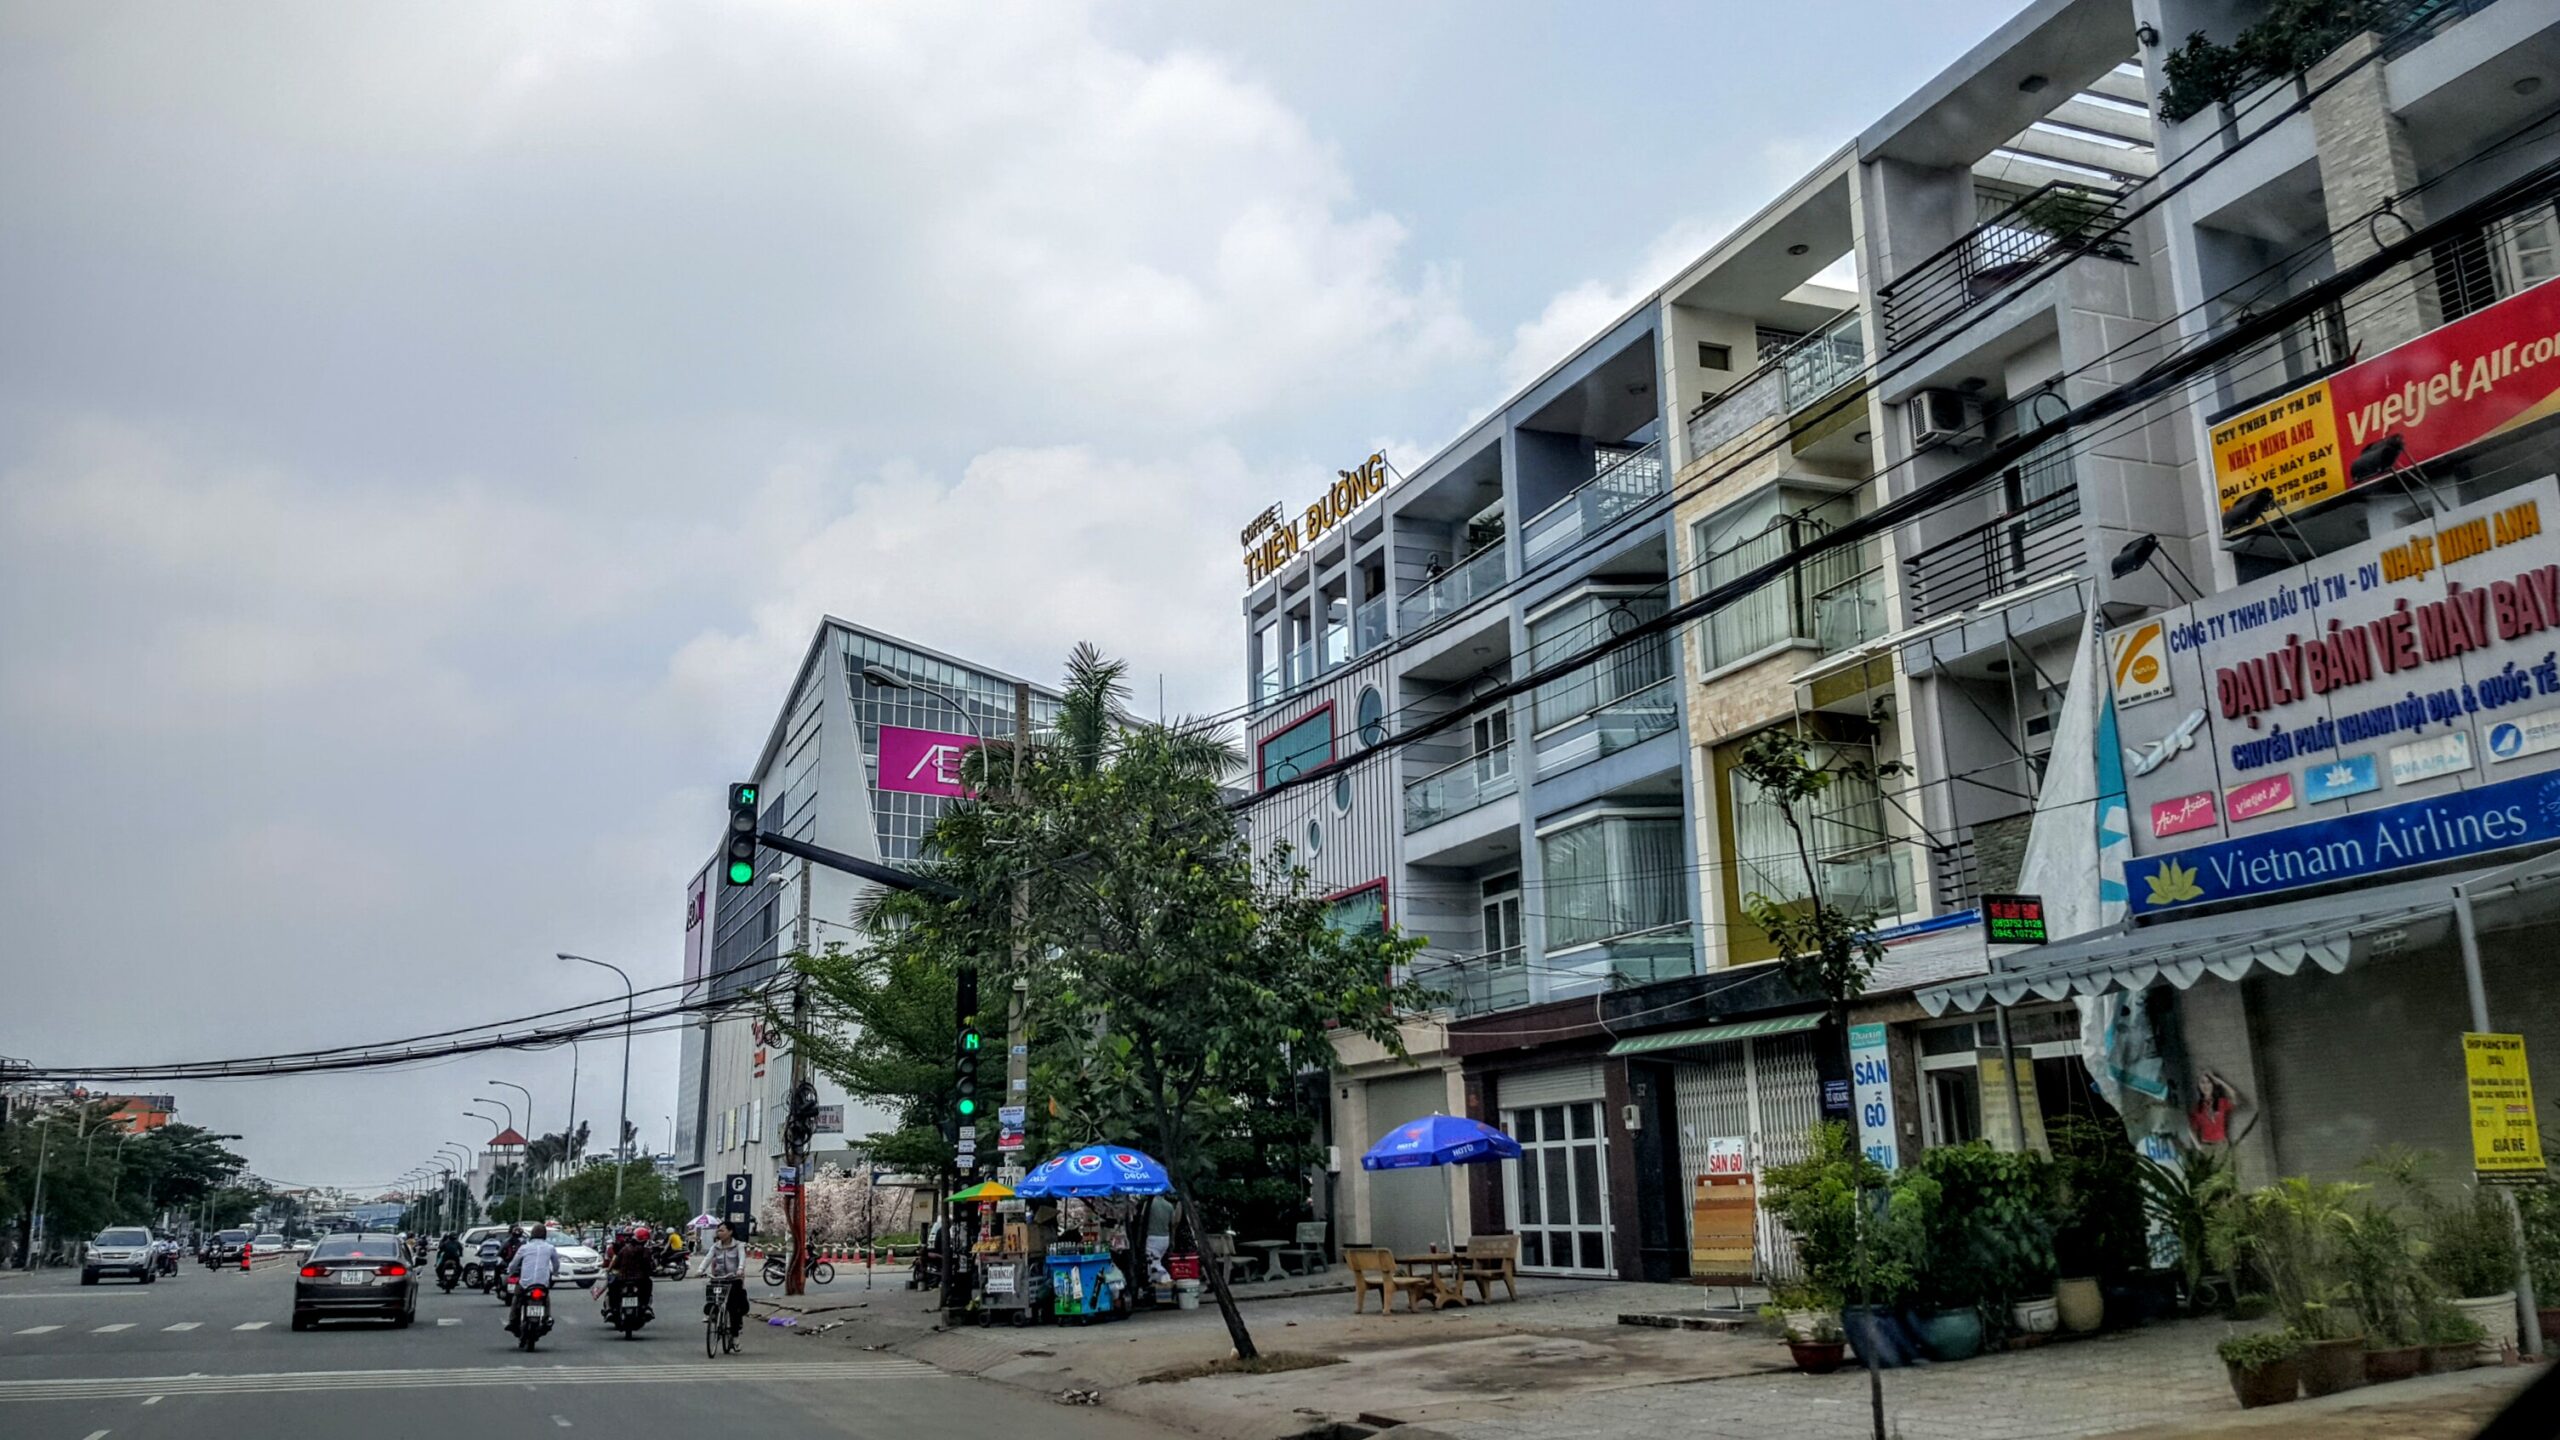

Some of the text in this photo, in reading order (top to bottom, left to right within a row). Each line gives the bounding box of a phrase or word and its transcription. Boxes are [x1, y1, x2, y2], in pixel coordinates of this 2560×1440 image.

[2215, 427, 2236, 446] CTY
[2238, 413, 2268, 436] TNHH
[2287, 398, 2305, 414] TM
[2227, 418, 2315, 473] NHẬT MINH ANH
[2221, 484, 2240, 500] ĐẠI
[2243, 471, 2258, 491] LÝ
[2279, 453, 2305, 475] MÁY
[2307, 443, 2334, 463] BAY
[2275, 466, 2327, 495] 3752 8128
[2289, 488, 2306, 503] 107
[2307, 481, 2329, 496] 258
[1306, 453, 1386, 543] ĐƯỜNG
[1240, 505, 1277, 547] COFFEE
[2169, 622, 2207, 654] CÔNG
[2208, 613, 2226, 640] TY
[2229, 604, 2268, 634] TNHH
[2269, 584, 2299, 622] ĐẦU
[2300, 576, 2321, 610] TƯ
[2322, 573, 2348, 602] TM
[2358, 562, 2379, 592] DV
[2379, 534, 2435, 584] NHẬT
[2436, 516, 2493, 567] MINH
[2492, 499, 2543, 548] ANH
[2216, 563, 2560, 731] ĐẠI LÝ BÁN VÉ MÁY BAY
[2293, 716, 2335, 757] PHÁT
[2337, 705, 2397, 745] NHANH
[2394, 691, 2429, 734] NỘI
[2427, 688, 2463, 727] ĐỊA
[2461, 684, 2480, 719] &
[2478, 660, 2533, 710] QUỐC
[2531, 650, 2560, 695] TẾ
[2208, 804, 2528, 890] Vietnam Airlines
[966, 1033, 979, 1049] 14
[1855, 1054, 1889, 1087] SÀN
[1864, 1090, 1887, 1129] GỖ
[1710, 1144, 1743, 1173] SÀN GỖ
[735, 1179, 744, 1190] P
